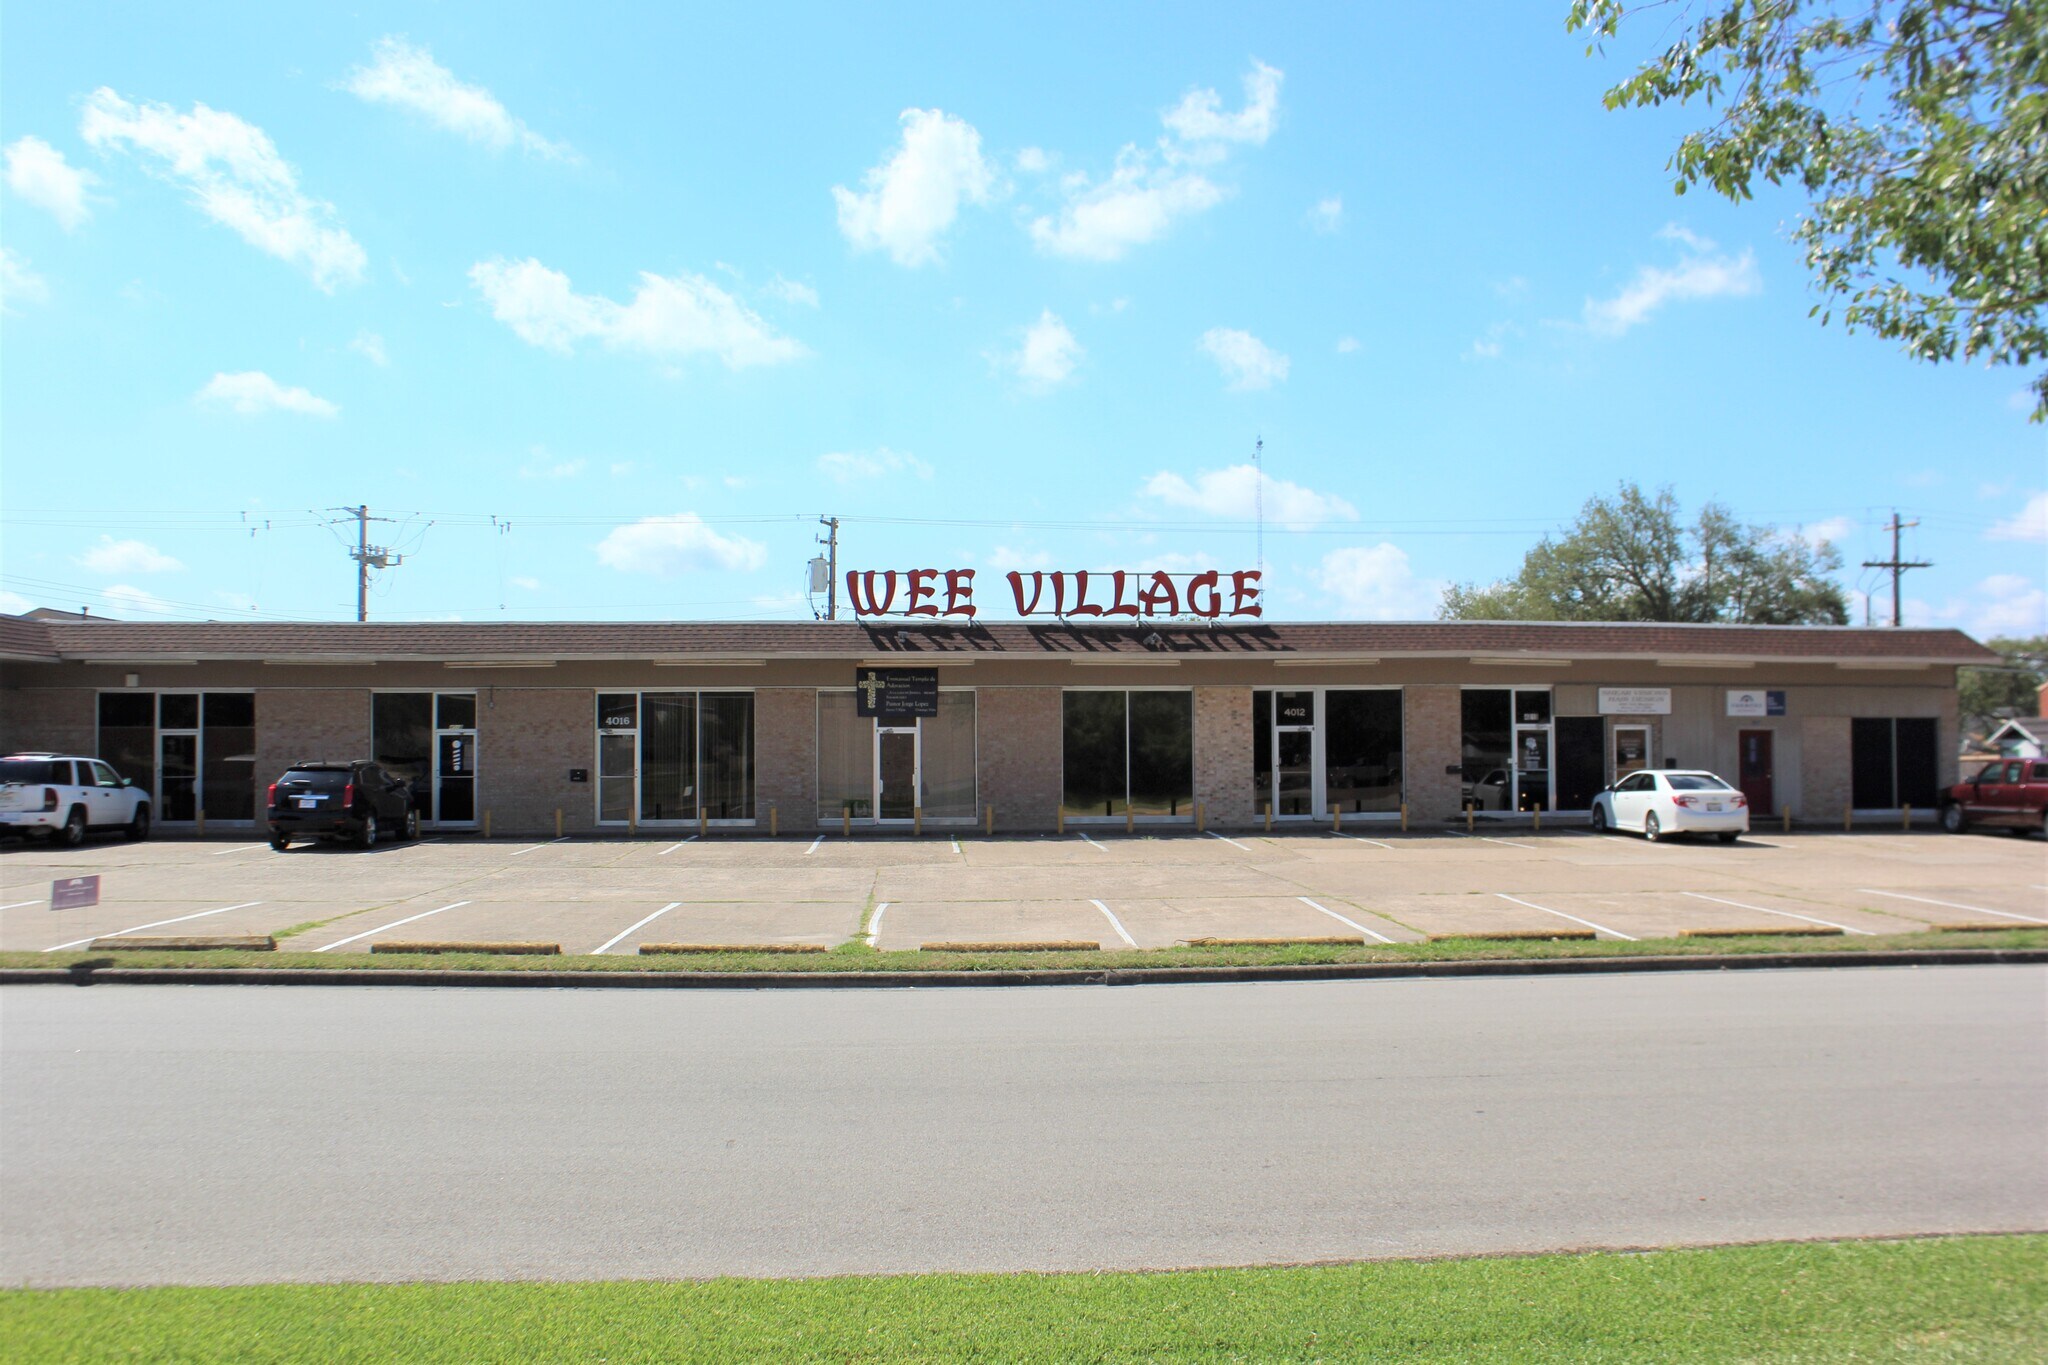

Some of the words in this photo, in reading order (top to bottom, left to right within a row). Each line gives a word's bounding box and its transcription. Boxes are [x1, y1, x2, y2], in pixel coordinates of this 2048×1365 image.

[846, 569, 976, 617] WEE
[1006, 570, 1262, 618] VILLAGE
[1284, 708, 1306, 716] 4012
[605, 717, 630, 725] 4016
